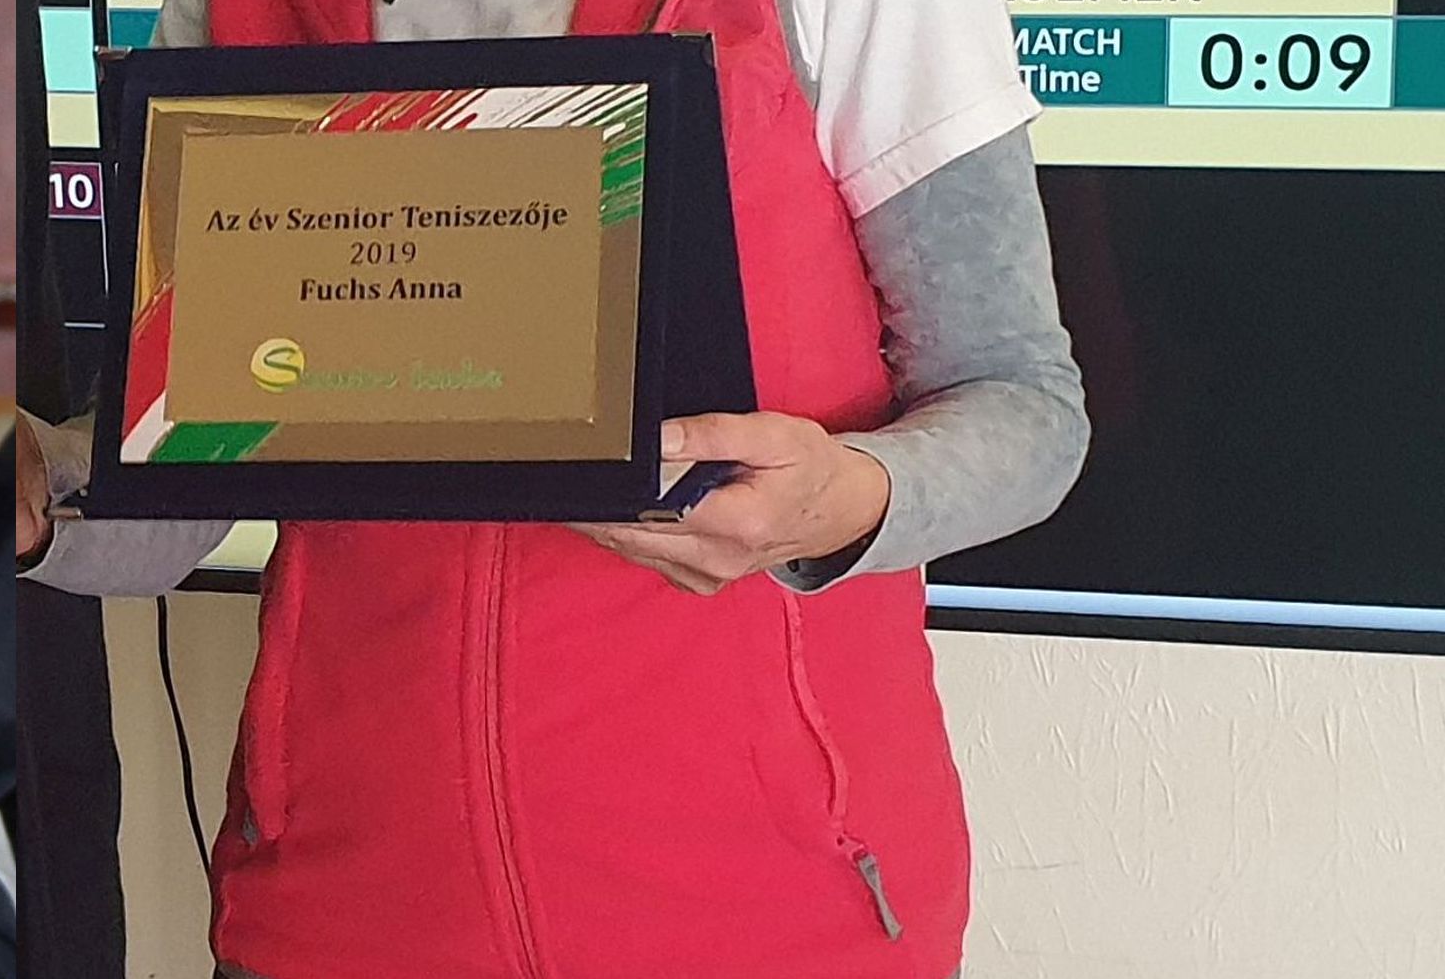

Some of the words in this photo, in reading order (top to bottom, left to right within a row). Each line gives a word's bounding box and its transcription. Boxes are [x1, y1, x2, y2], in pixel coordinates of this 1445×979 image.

[1013, 27, 1122, 56] MATCH
[1200, 32, 1371, 92] 0:09
[1018, 63, 1102, 93] Time
[49, 173, 94, 209] 10
[206, 209, 240, 231] Az
[248, 207, 279, 231] év
[286, 206, 394, 231] Szenior
[401, 201, 569, 230] Teniszezője
[350, 241, 417, 266] 2019
[300, 277, 381, 301] Fuchs
[389, 278, 463, 301] Anna
